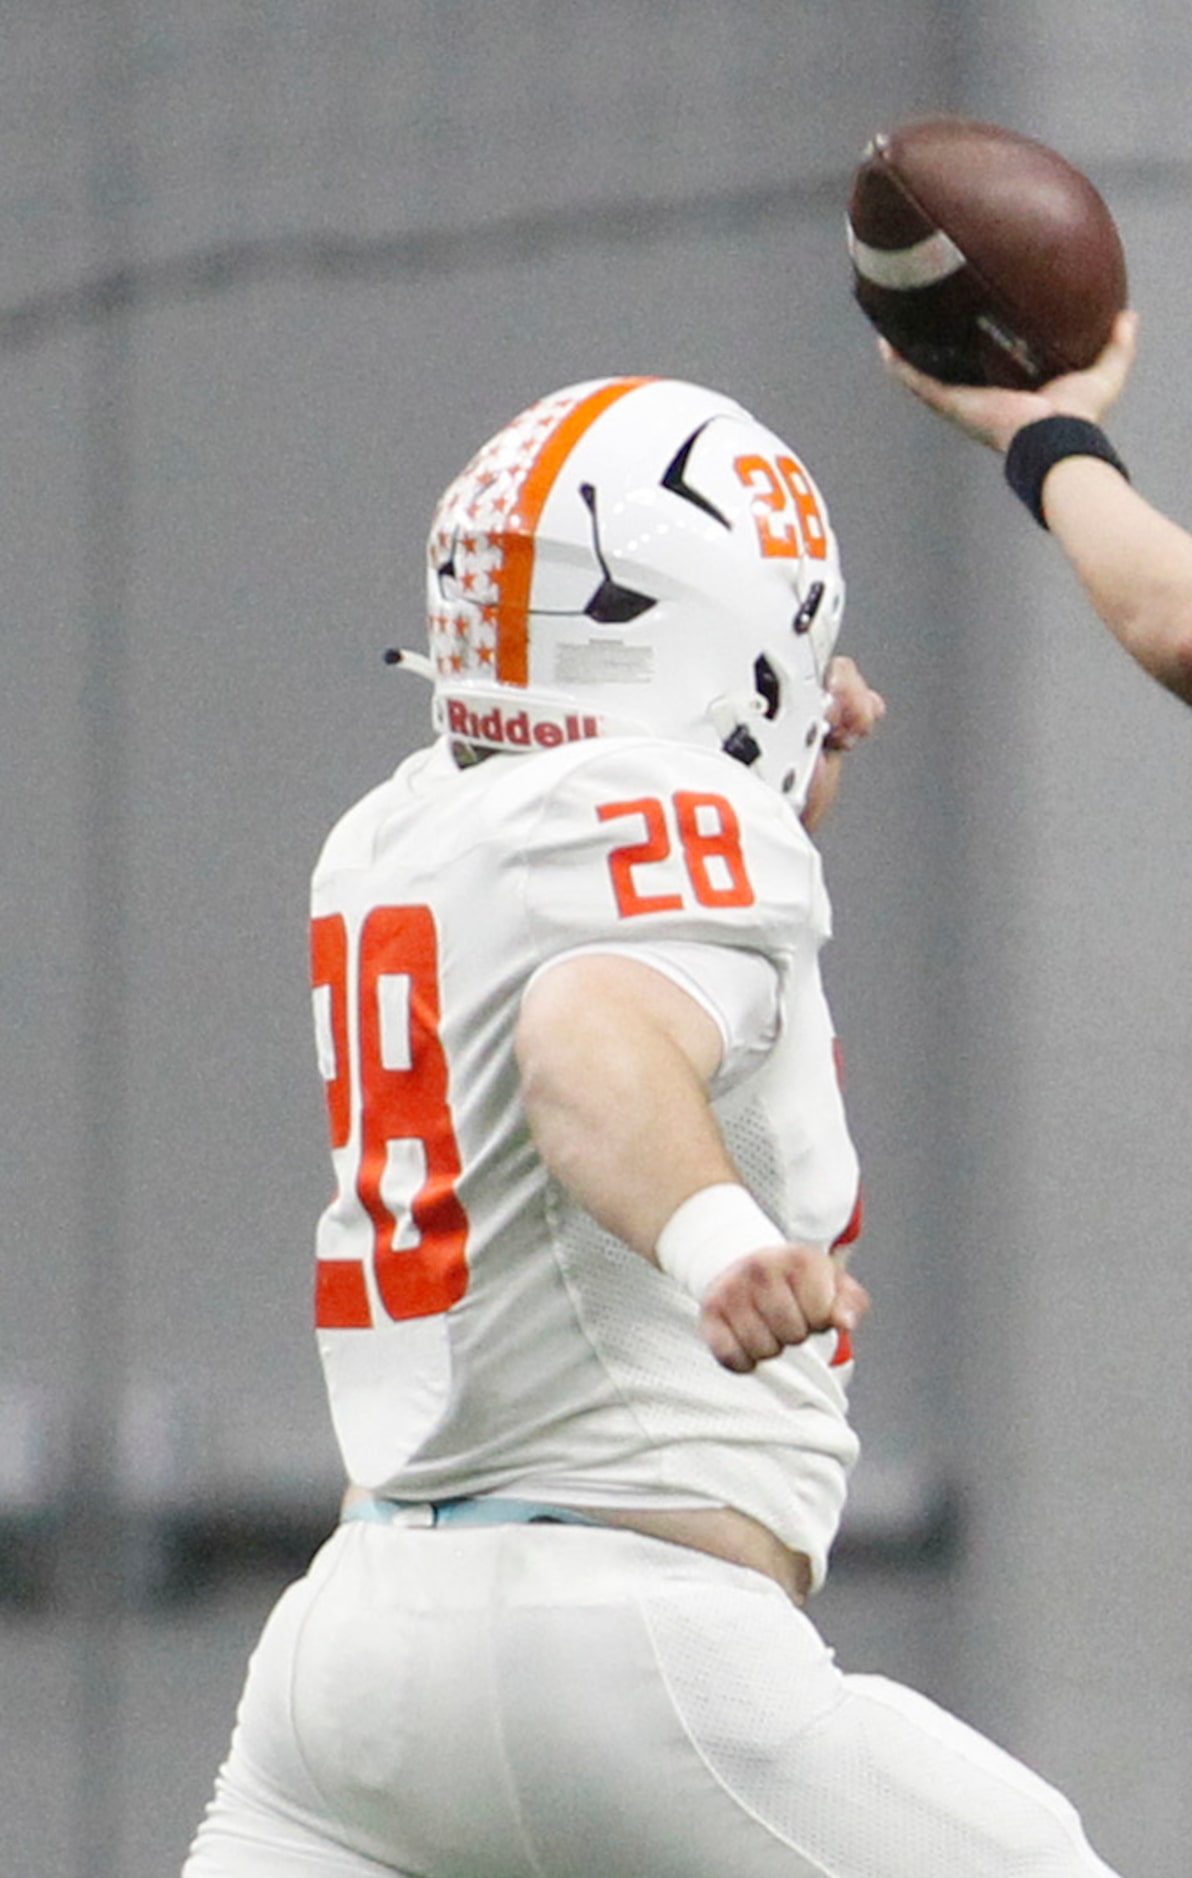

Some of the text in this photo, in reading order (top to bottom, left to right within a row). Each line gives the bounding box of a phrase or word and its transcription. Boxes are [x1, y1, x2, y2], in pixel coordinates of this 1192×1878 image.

[733, 454, 828, 561] 28
[447, 698, 600, 749] Riddell
[596, 790, 756, 920] 28
